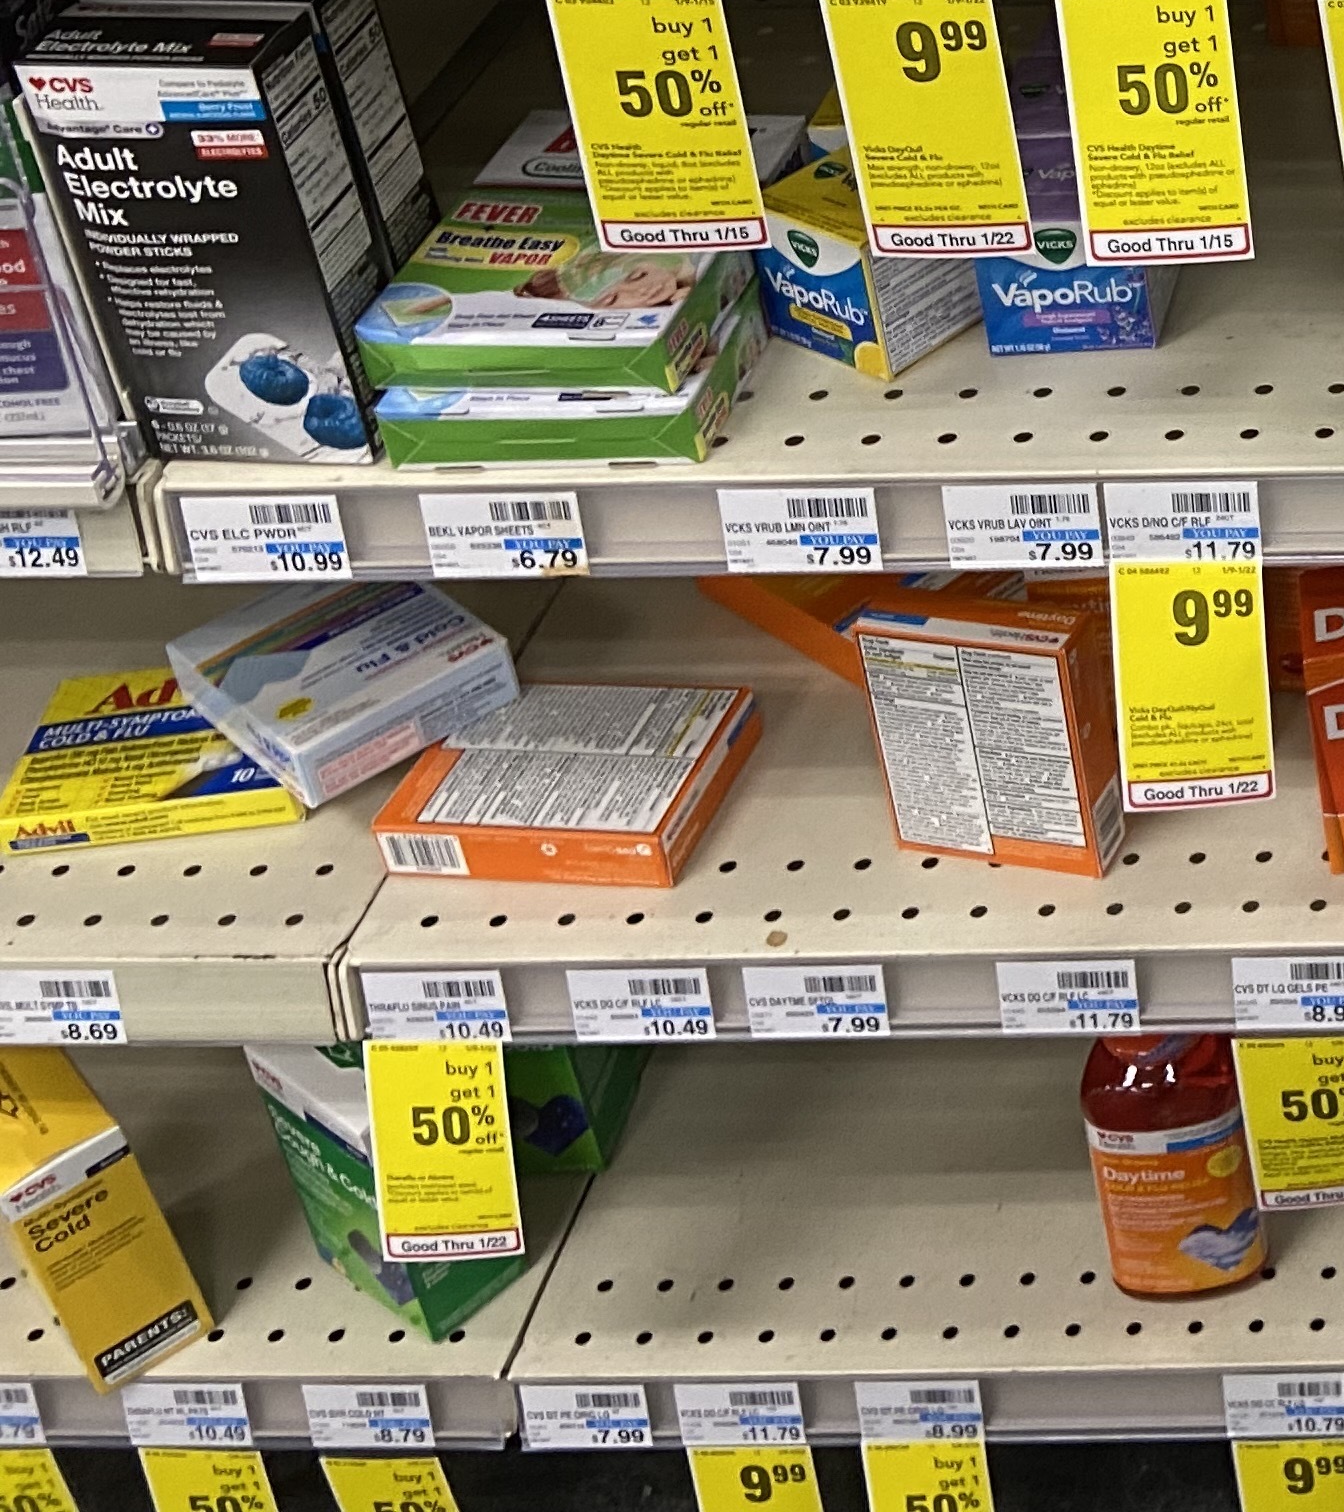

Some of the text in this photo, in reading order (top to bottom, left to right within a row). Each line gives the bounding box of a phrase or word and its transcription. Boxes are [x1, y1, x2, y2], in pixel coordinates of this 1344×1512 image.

[50, 78, 94, 93] CVS
[1117, 61, 1222, 115] 50%
[35, 93, 99, 111] Health
[57, 144, 138, 171] Adult
[63, 172, 237, 203] Electrolyte
[74, 199, 129, 226] Mix
[452, 202, 542, 225] FEVER
[171, 233, 238, 244] WRAPPED
[436, 232, 566, 254] Breathe Easy
[1037, 239, 1074, 250] VICKS
[488, 249, 552, 267] VAPOR
[765, 267, 870, 329] VapoRub
[992, 277, 1132, 309] VapoRub
[190, 529, 296, 540] CVS ELC PWDR
[270, 548, 344, 571] $10.99
[512, 545, 582, 569] $6.79
[1029, 542, 1093, 560] $7.99
[1185, 541, 1255, 559] $11.79
[39, 734, 92, 751] COLD
[113, 724, 150, 739] FLU
[230, 768, 255, 783] 10
[61, 1023, 117, 1040] $8.69
[412, 1105, 497, 1146] 50%
[1102, 1165, 1186, 1184] Daytime
[28, 1190, 109, 1239] Severe
[35, 1214, 91, 1253] Cold
[186, 1422, 250, 1441] $10.49
